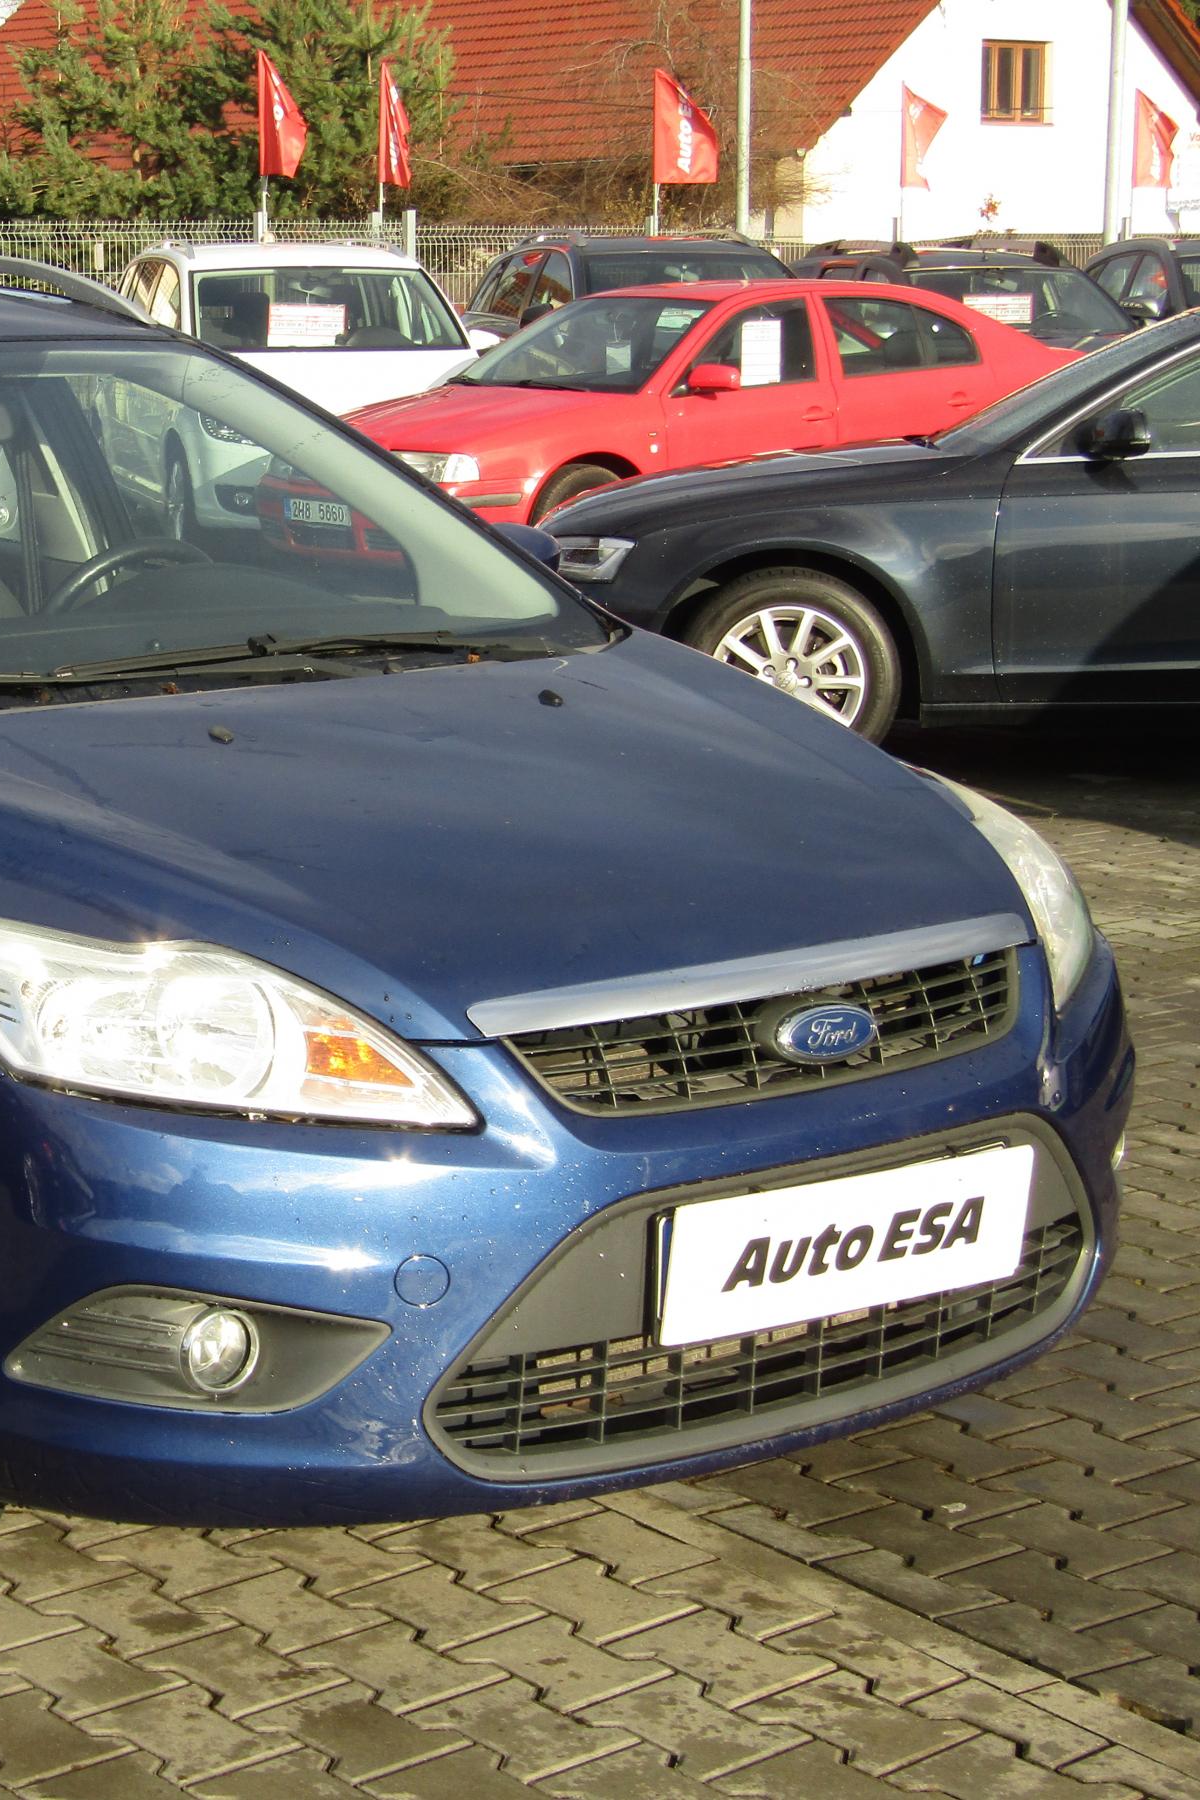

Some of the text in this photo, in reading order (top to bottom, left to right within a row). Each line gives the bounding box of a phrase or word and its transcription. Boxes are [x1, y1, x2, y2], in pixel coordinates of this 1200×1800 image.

[677, 119, 694, 175] Auto
[808, 1016, 858, 1050] Ford
[721, 1196, 985, 1293] Auto ESA
